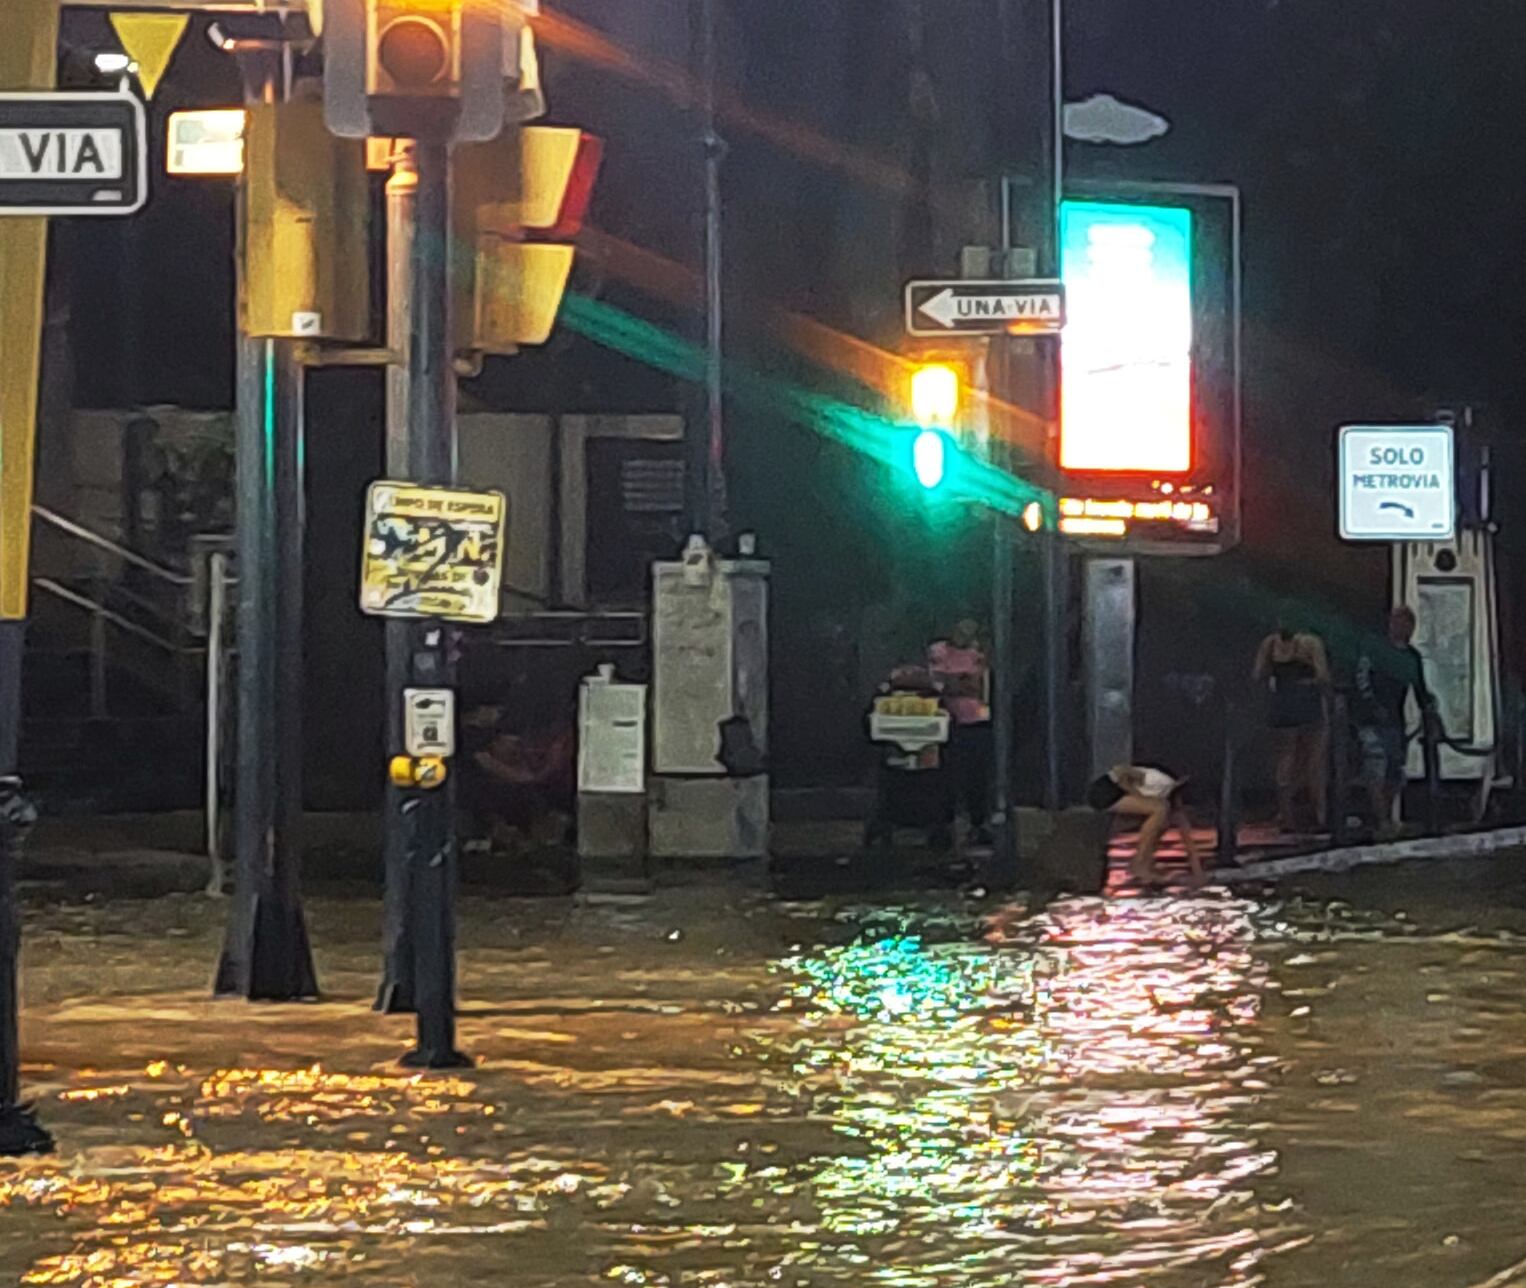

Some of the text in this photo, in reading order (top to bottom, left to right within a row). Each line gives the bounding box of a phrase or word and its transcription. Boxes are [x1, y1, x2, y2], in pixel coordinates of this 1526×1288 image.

[18, 132, 105, 173] VIA
[957, 298, 1052, 316] UNA VIA
[1369, 447, 1424, 465] SOLO
[1352, 474, 1440, 489] METROVIA
